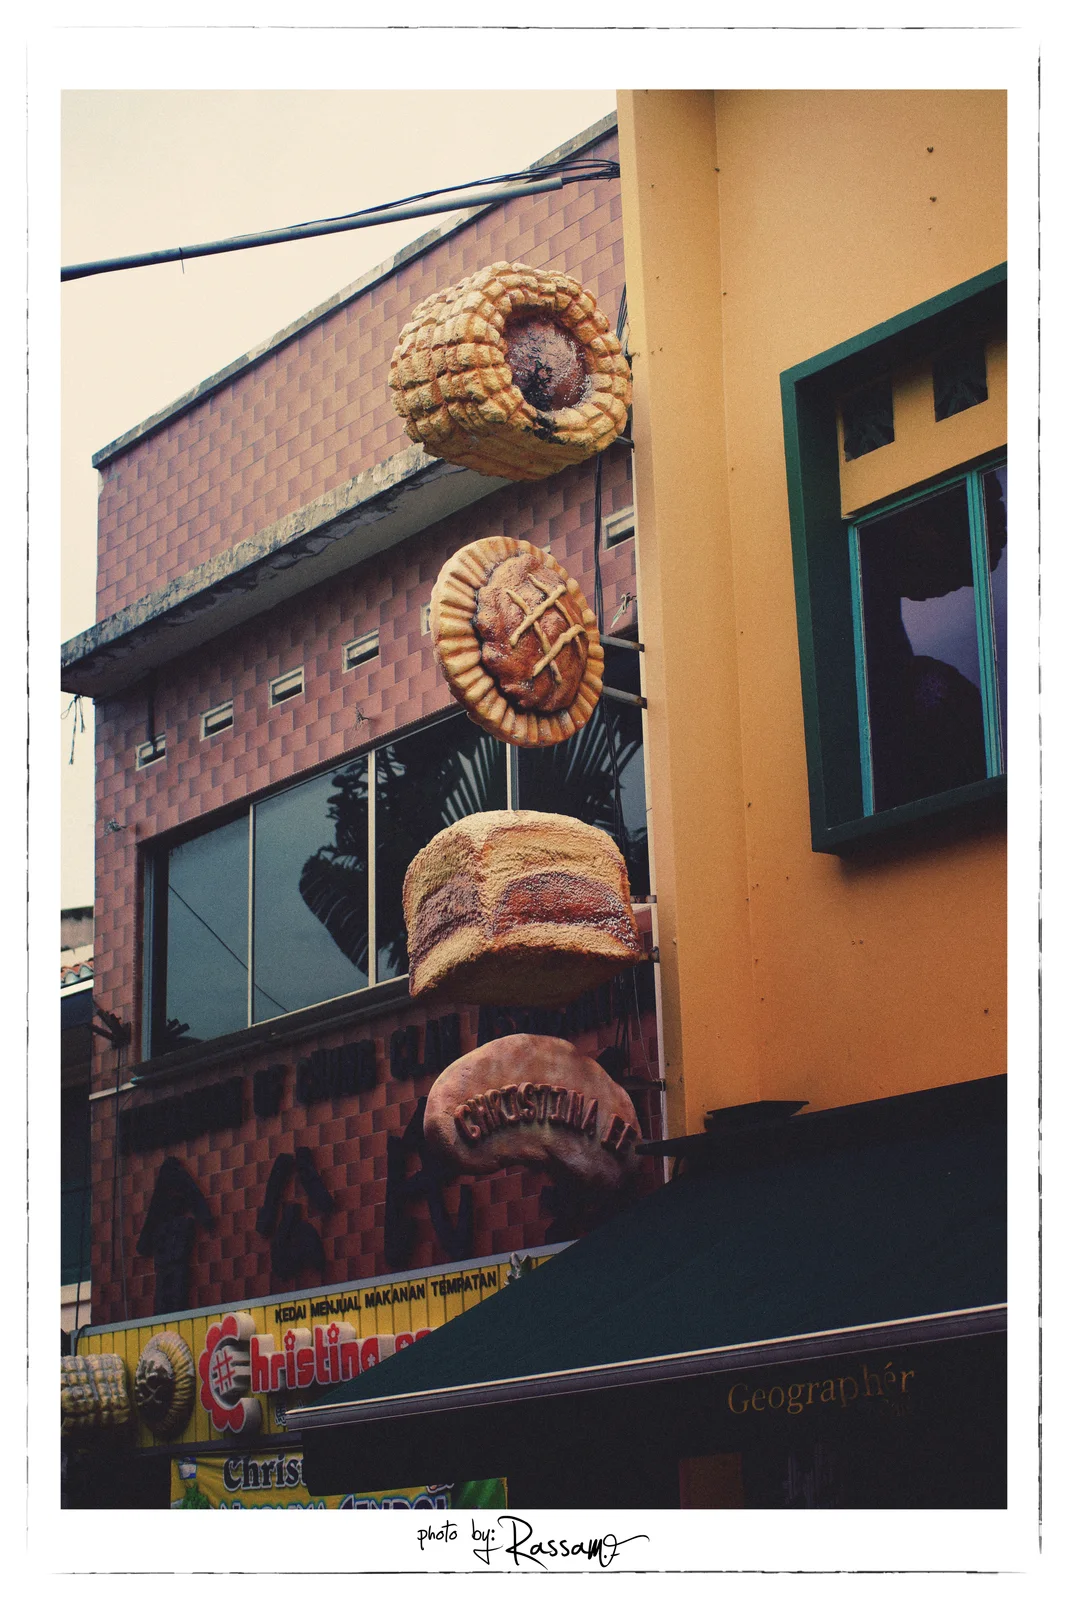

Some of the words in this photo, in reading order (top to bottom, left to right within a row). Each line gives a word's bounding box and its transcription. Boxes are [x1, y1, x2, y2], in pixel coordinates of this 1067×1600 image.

[454, 1081, 599, 1141] CHRISTINA
[275, 1304, 306, 1323] KEDAI
[310, 1295, 361, 1318] MENJUAL
[365, 1284, 426, 1308] MAKANAN
[431, 1271, 497, 1297] TEMPATAN
